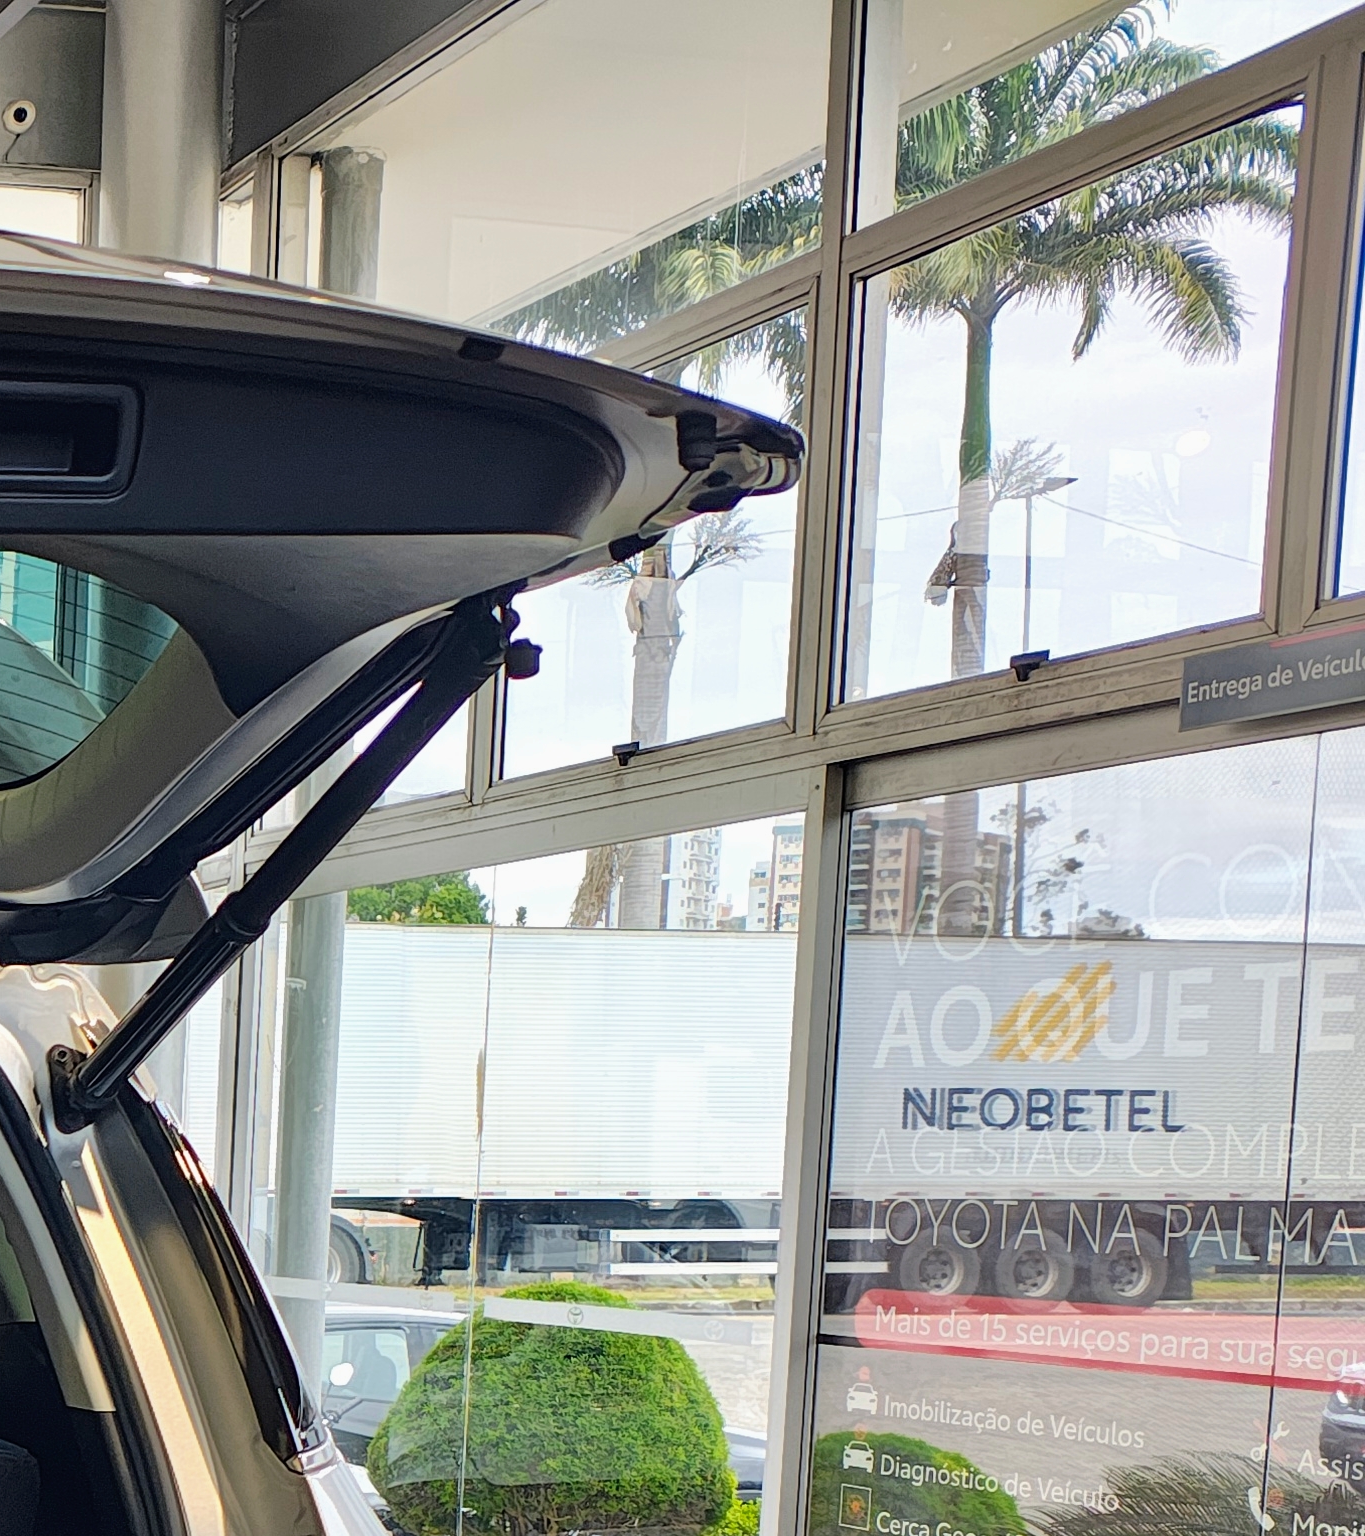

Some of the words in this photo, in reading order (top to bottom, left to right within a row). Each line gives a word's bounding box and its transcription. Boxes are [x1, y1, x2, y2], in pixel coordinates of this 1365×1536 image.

[1187, 674, 1263, 704] Entrega
[1267, 664, 1294, 688] de
[872, 984, 993, 1069] AO
[1017, 966, 1214, 1064] QUE
[1243, 955, 1359, 1054] TE
[901, 1087, 1188, 1133] NEOBETEL
[865, 1127, 894, 1175] A
[862, 1198, 1047, 1251] TOYOTA
[1067, 1201, 1141, 1256] NA
[1163, 1203, 1358, 1266] PALMA
[875, 1305, 931, 1336] Mais
[938, 1309, 971, 1339] de
[979, 1313, 1007, 1343] 15
[1015, 1321, 1131, 1358] serviços
[1140, 1332, 1209, 1362] para
[1219, 1339, 1275, 1366] sua
[884, 1395, 1011, 1433] Imobilização
[1016, 1411, 1044, 1436] de
[1050, 1414, 1145, 1449] Veículos
[880, 1453, 999, 1493] Diagnóstico
[1004, 1473, 1032, 1498] de
[1037, 1477, 1121, 1513] Veículo
